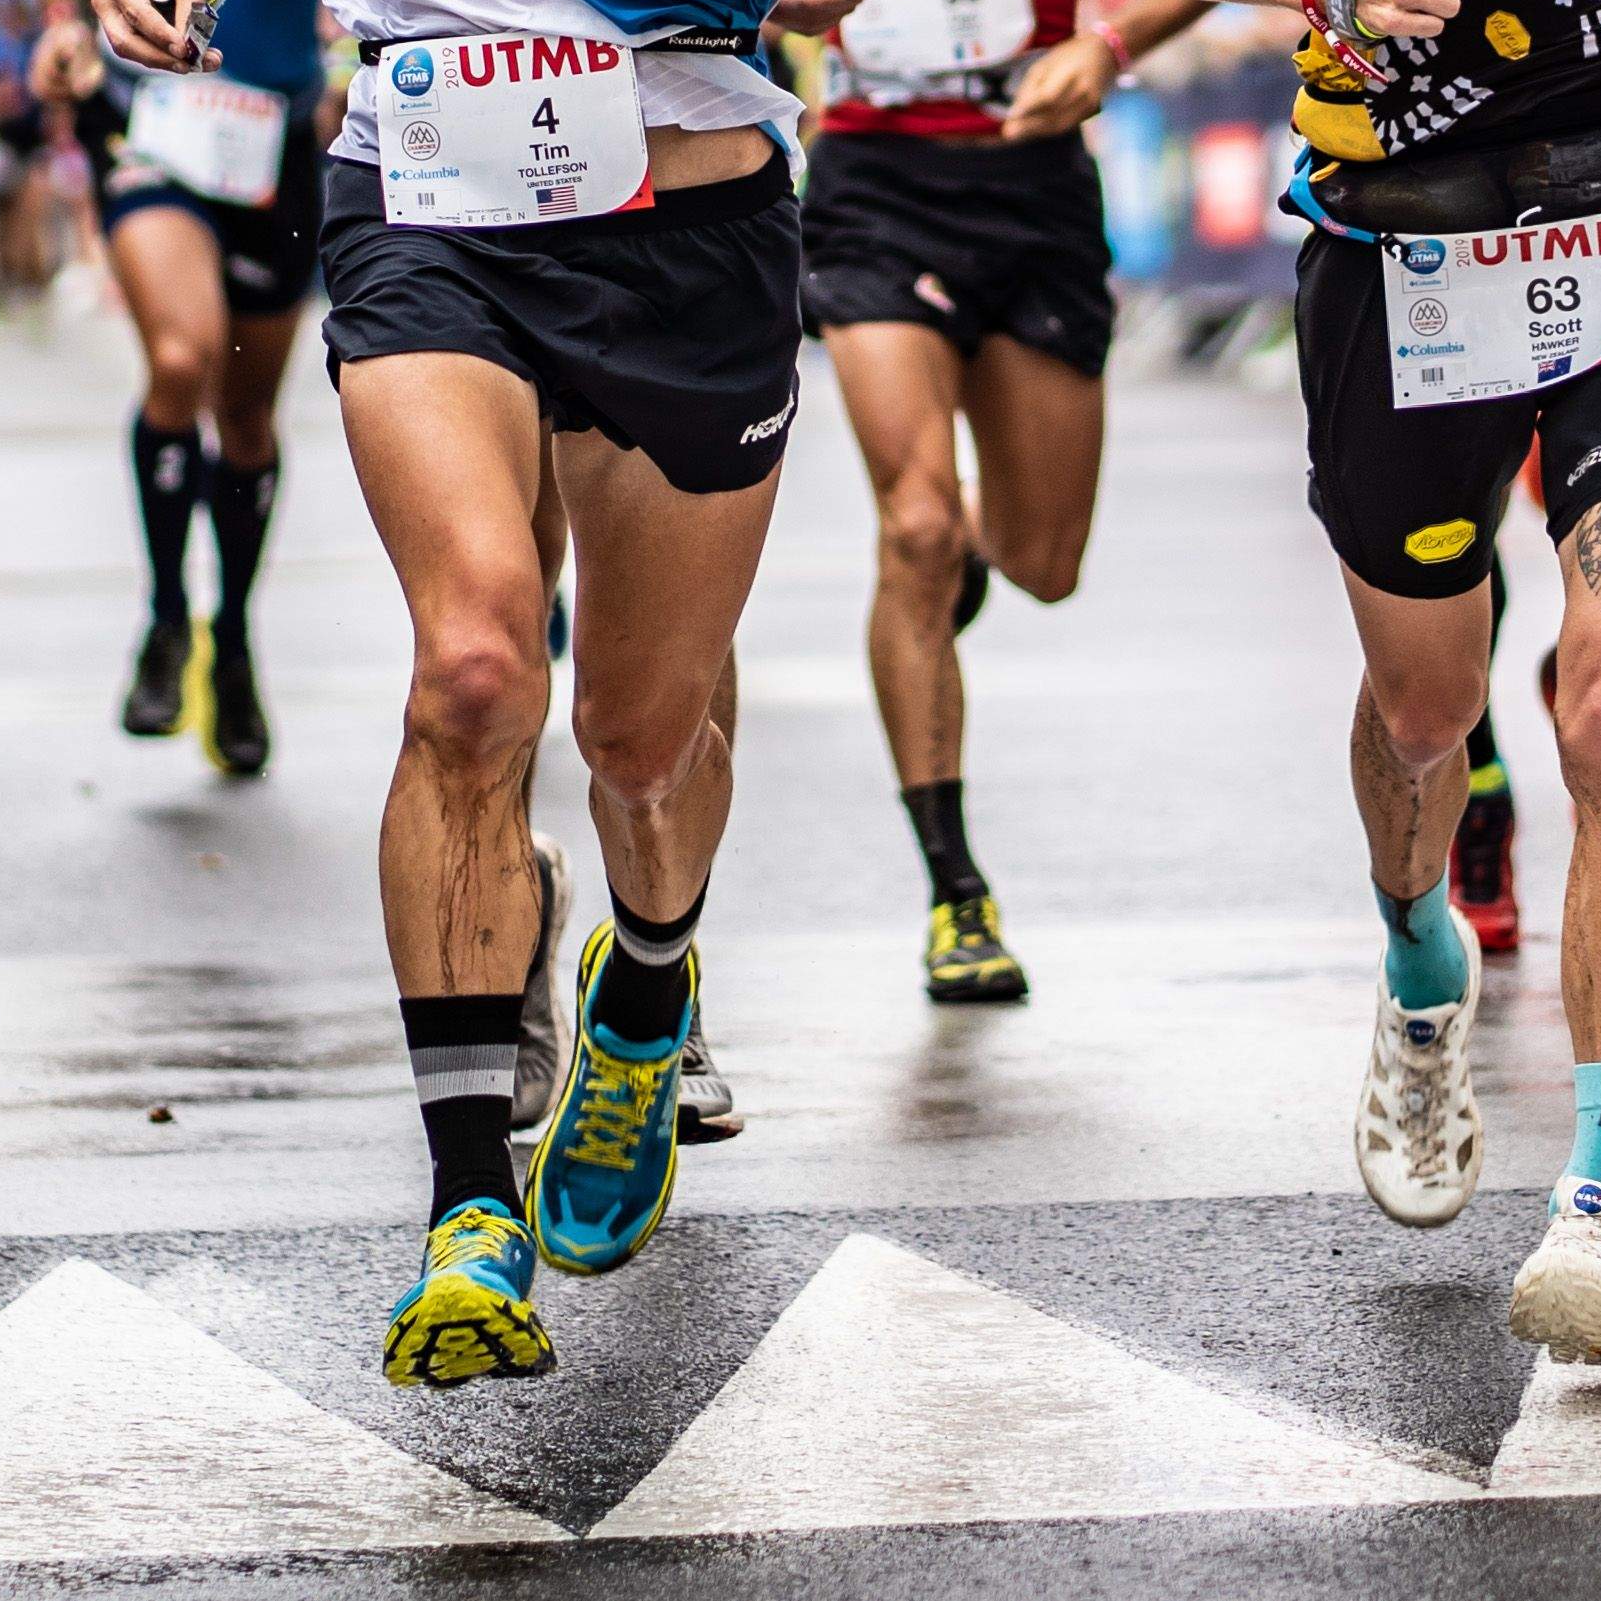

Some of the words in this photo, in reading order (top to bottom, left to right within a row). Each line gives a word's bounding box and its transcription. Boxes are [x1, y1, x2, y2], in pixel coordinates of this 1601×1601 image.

[1306, 7, 1328, 32] UTMB
[443, 47, 460, 89] 2019
[458, 36, 621, 88] UTMB
[397, 72, 429, 85] UTMB
[531, 97, 560, 135] 4
[529, 143, 570, 162] Tim
[402, 167, 460, 181] Columbia
[518, 161, 588, 179] TOLLEFSON
[526, 178, 553, 189] UNITED
[554, 175, 583, 187] STATES
[1408, 254, 1441, 264] UTMB
[1454, 238, 1470, 268] 2019
[1526, 275, 1581, 315] 63
[1528, 317, 1583, 338] Scott
[1409, 342, 1465, 358] Columbia
[1531, 336, 1580, 352] HAWKER
[1531, 353, 1547, 362] NEW
[1548, 346, 1580, 360] ZEALAND
